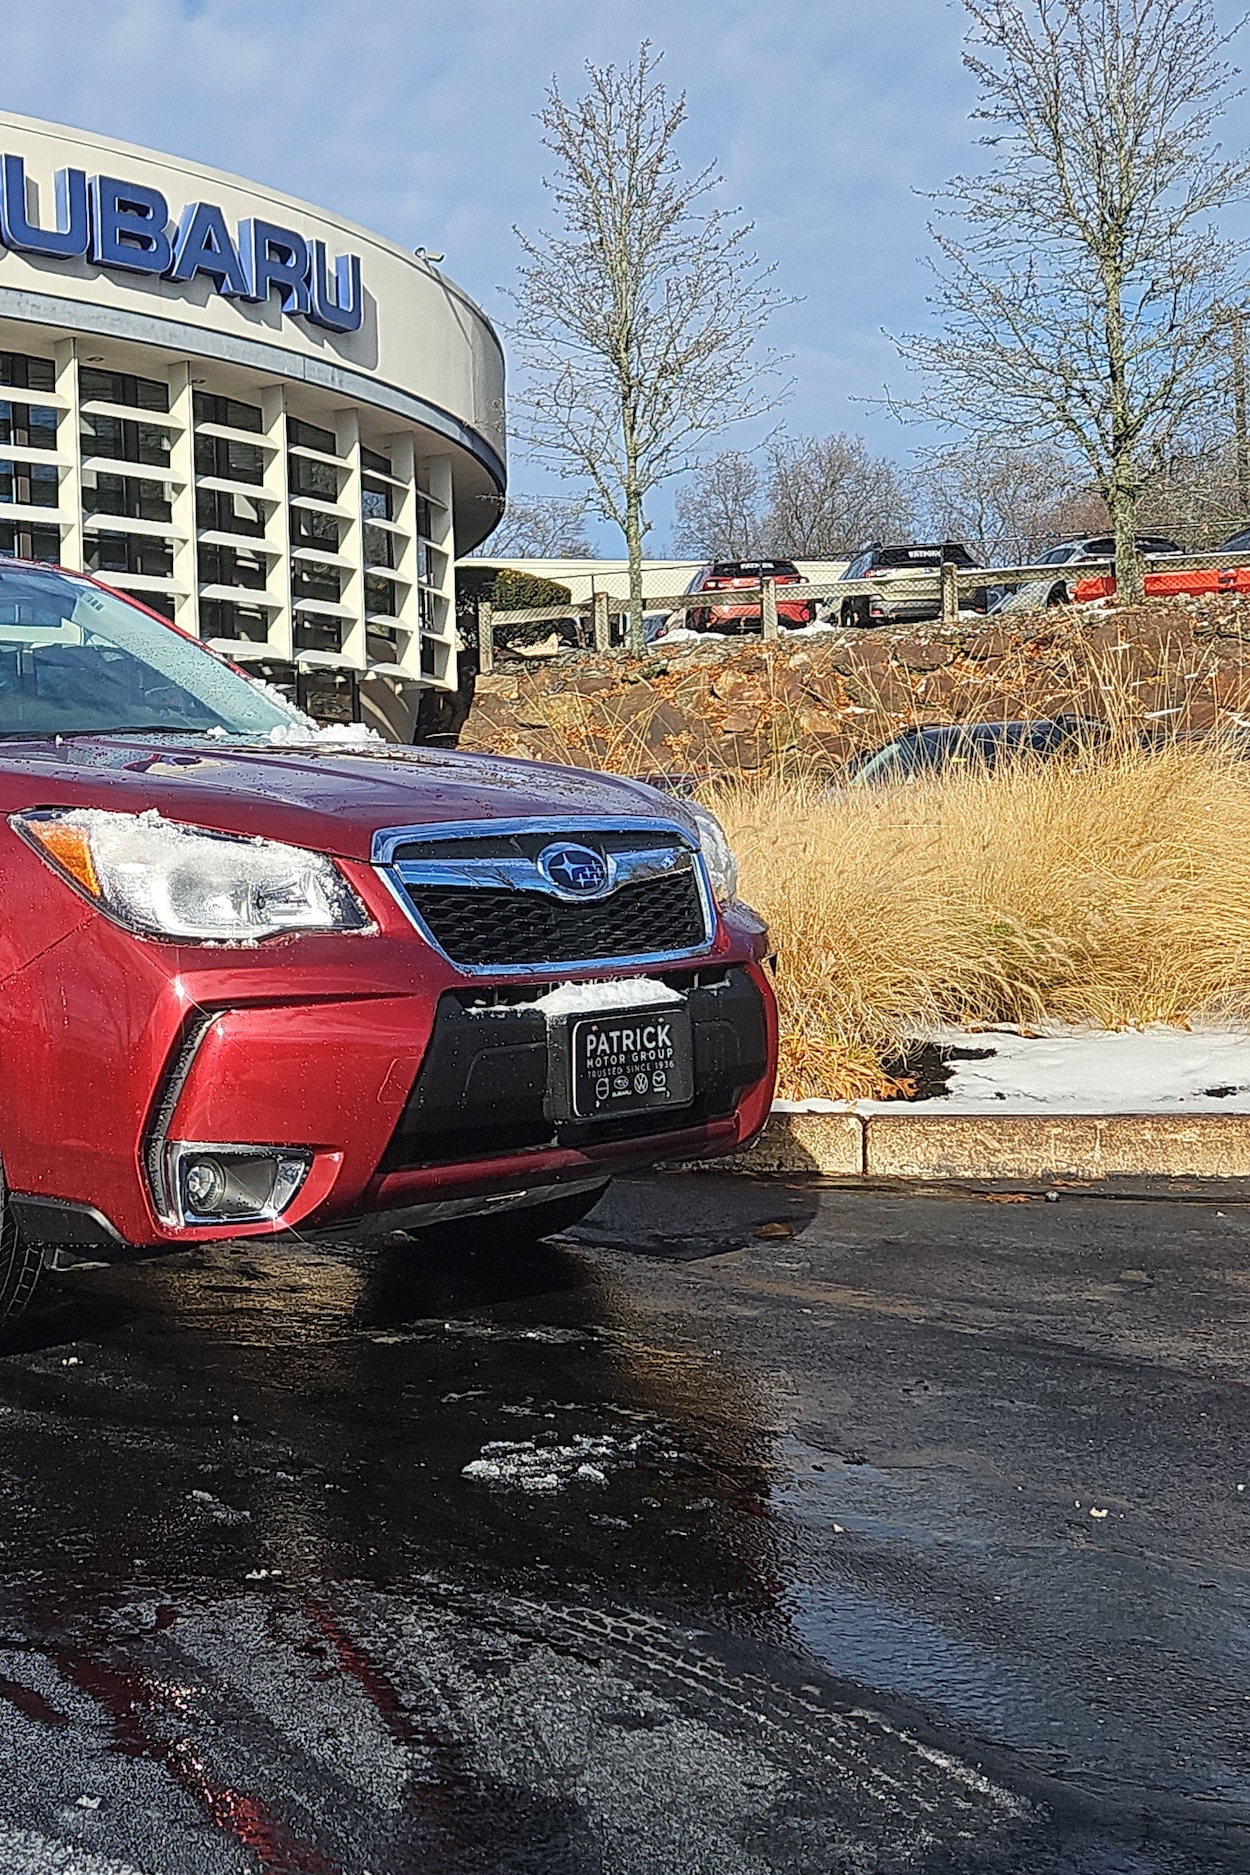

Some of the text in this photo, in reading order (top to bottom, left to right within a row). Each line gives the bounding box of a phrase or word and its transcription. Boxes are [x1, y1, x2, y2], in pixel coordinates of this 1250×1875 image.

[586, 1024, 672, 1057] PATRICK
[586, 1048, 673, 1068] MOTOR GROUP
[588, 1060, 675, 1079] TRUSTED SINCE 1936
